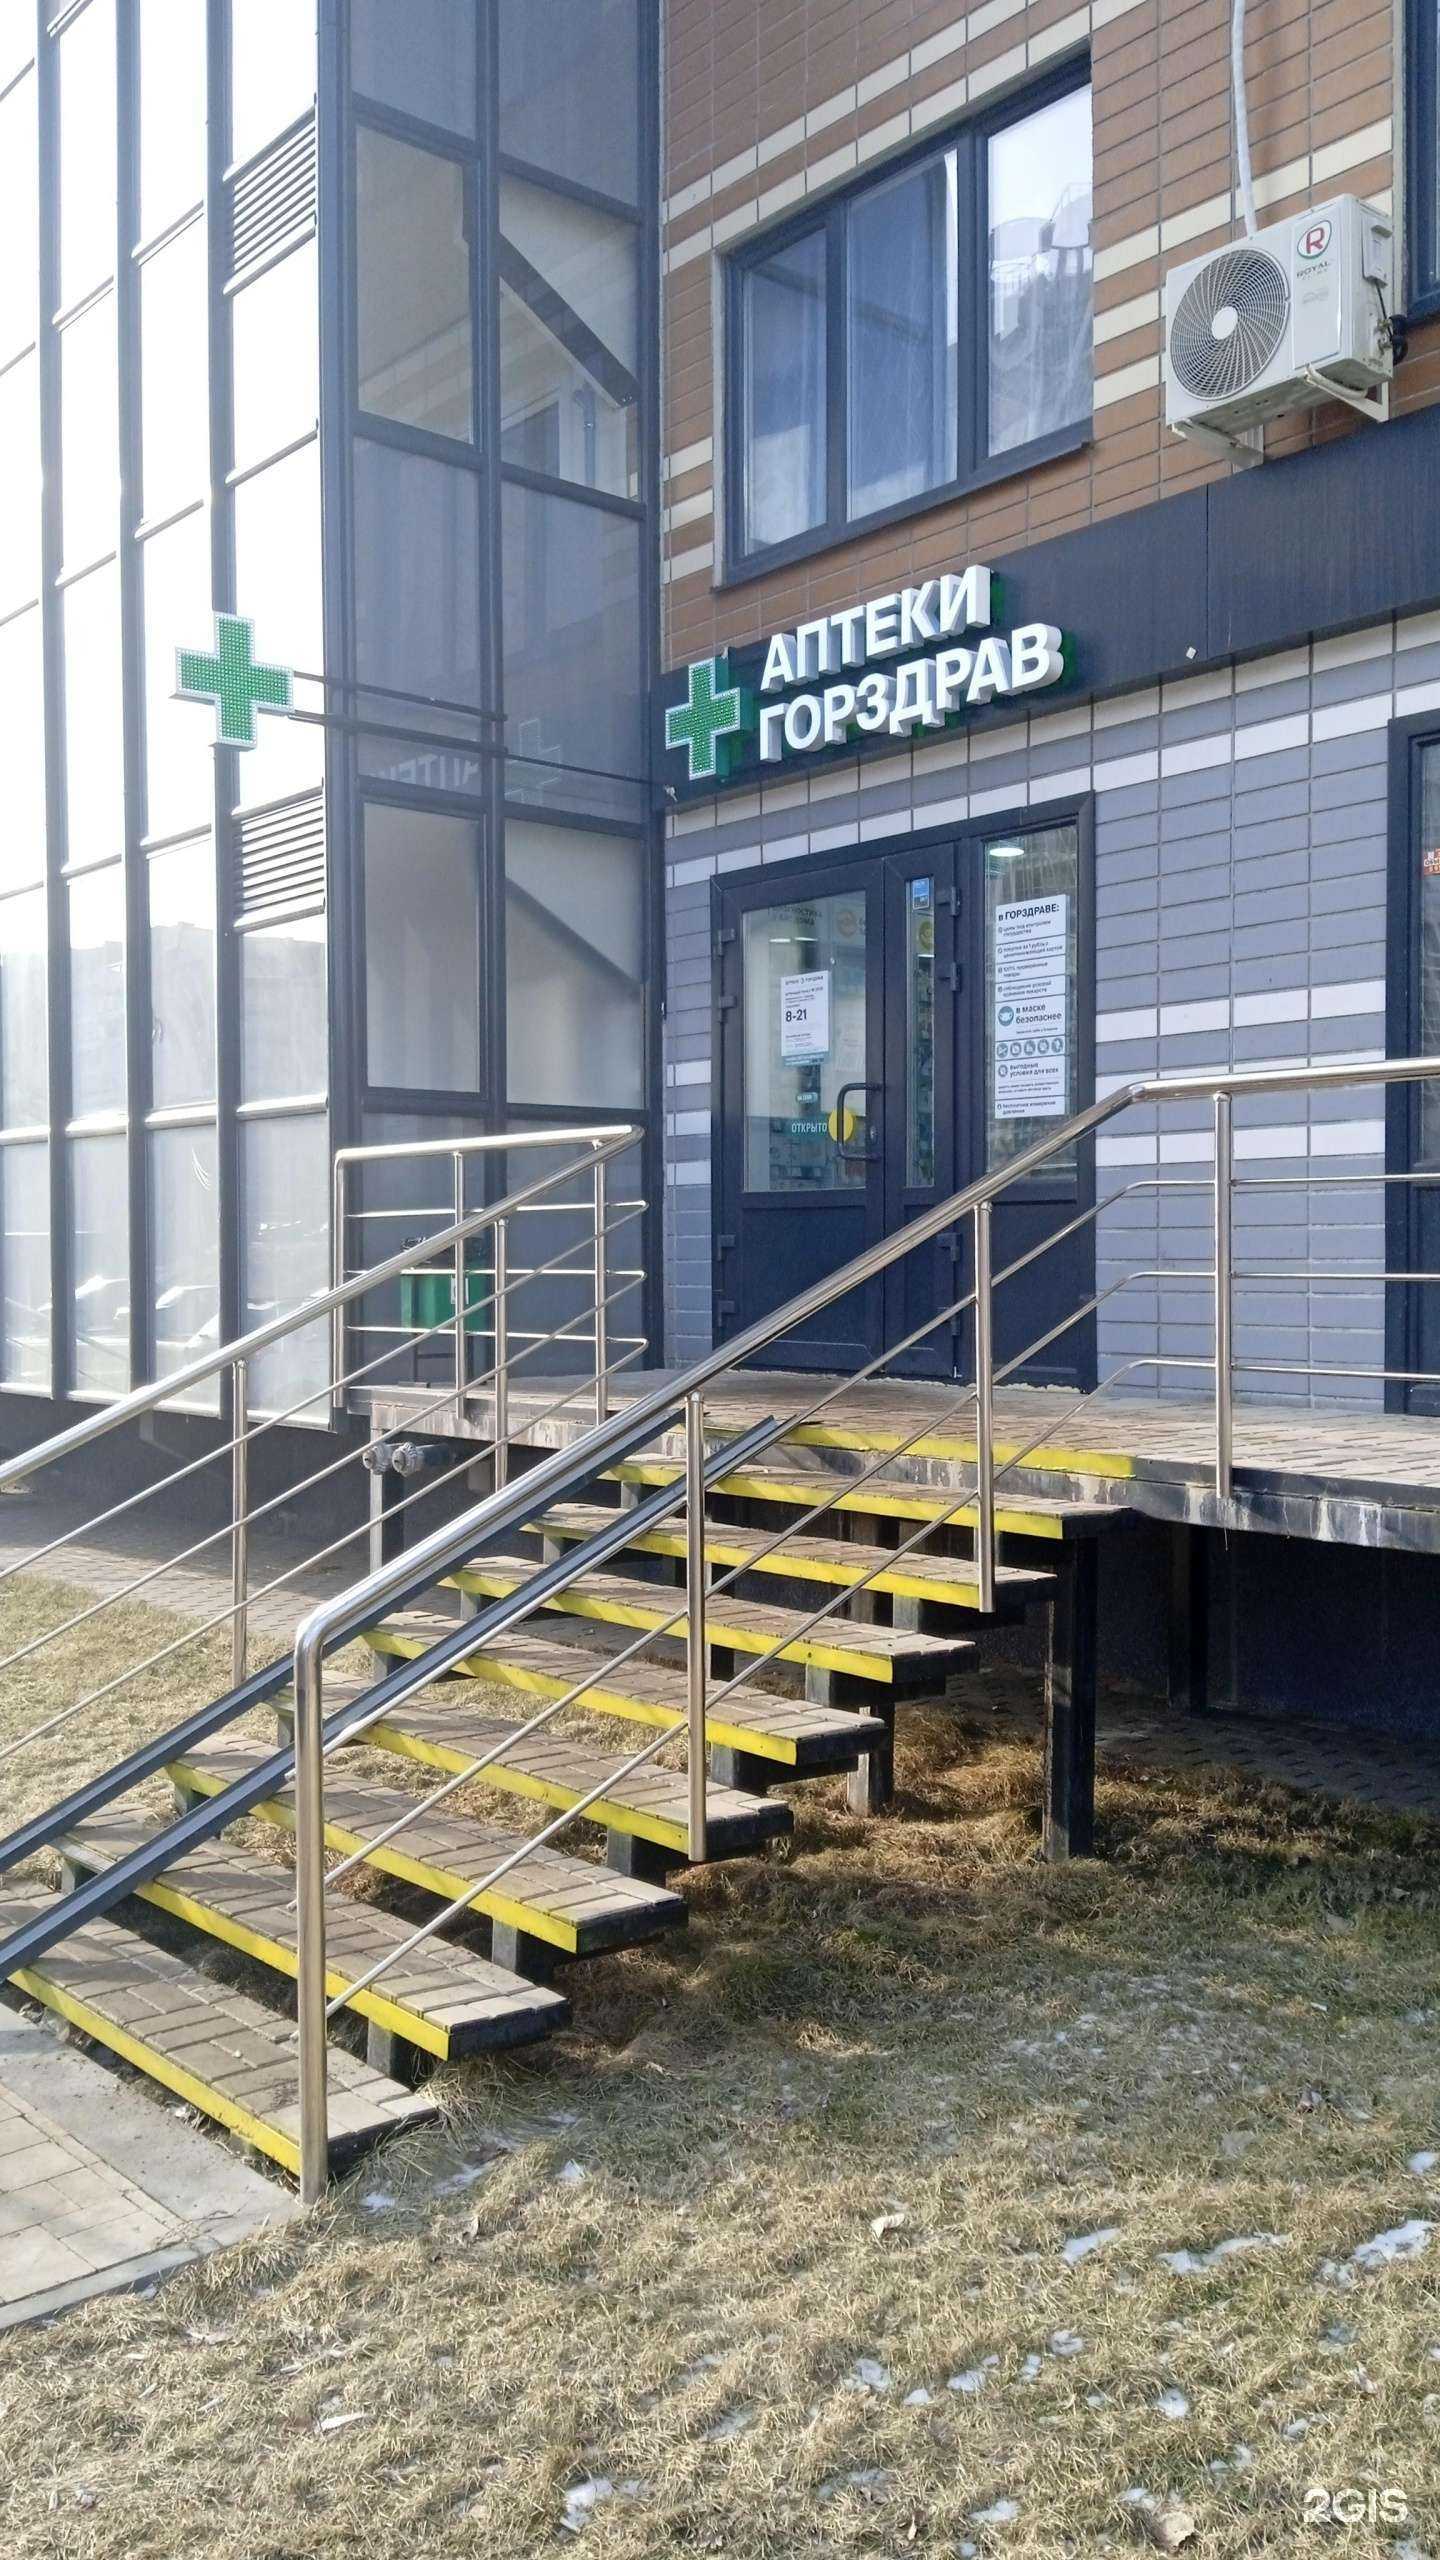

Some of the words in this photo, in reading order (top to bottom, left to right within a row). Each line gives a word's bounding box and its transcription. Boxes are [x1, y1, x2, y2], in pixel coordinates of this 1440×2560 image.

[1305, 227, 1325, 254] R
[760, 565, 991, 693] АПТЕКИ
[759, 622, 1065, 763] ГОРЗДРАВ
[1005, 903, 1060, 920] ГОРЗДРАВЕ:
[785, 1009, 808, 1023] 8-21
[1016, 1013, 1062, 1024] безопаснее
[791, 1122, 828, 1133] ОТКРЫТО
